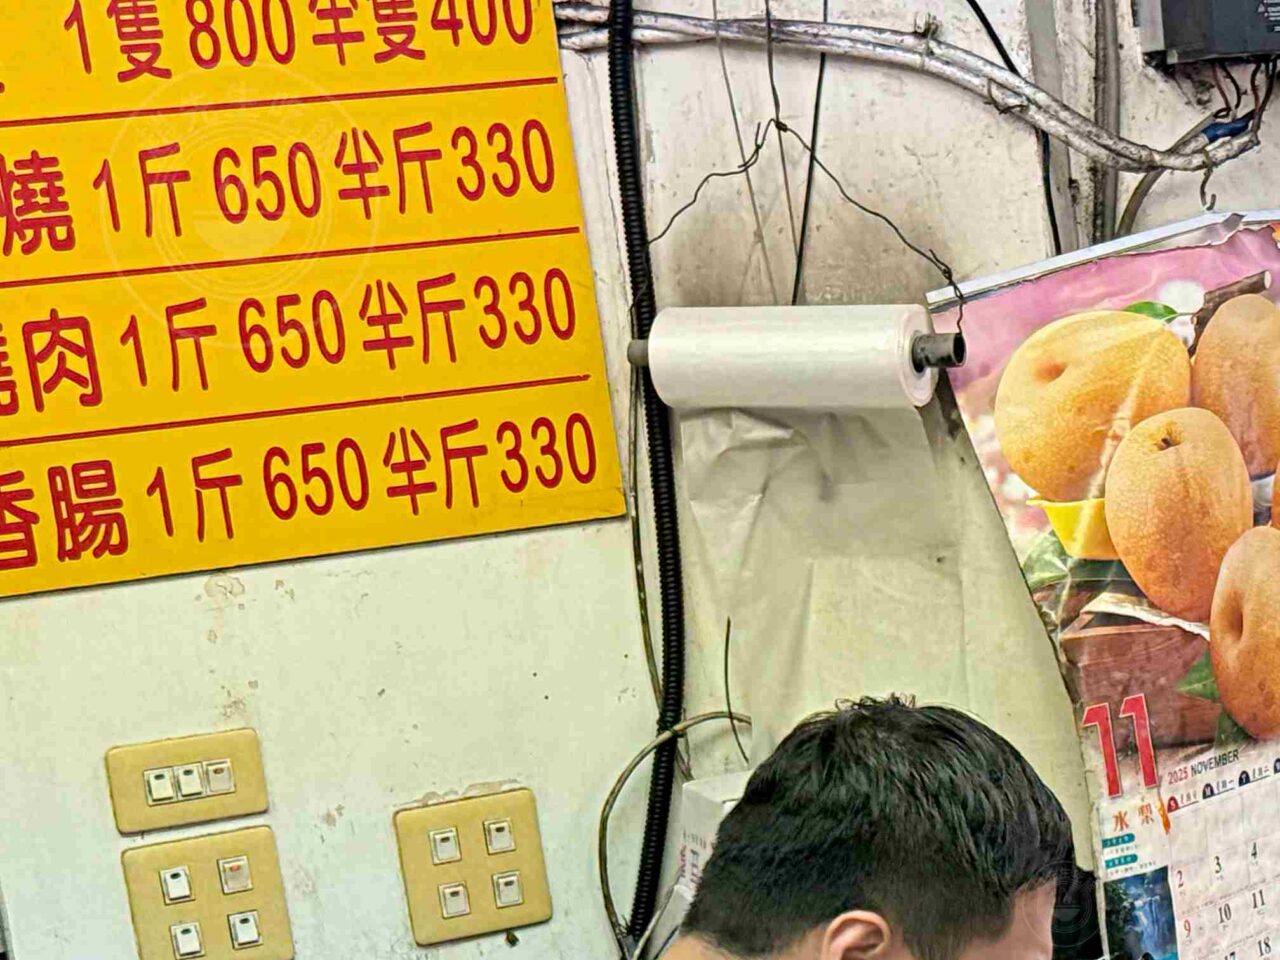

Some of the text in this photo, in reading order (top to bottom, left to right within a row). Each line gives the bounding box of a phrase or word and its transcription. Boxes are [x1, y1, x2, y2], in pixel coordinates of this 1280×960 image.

[0, 267, 577, 416] 肉1斤650半斤330
[1082, 693, 1159, 798] 11
[1167, 749, 1240, 785] 2025 NOVEMBER
[1177, 870, 1184, 888] 2
[1214, 856, 1222, 874] 3
[1251, 842, 1257, 859] 4
[1184, 919, 1191, 938] 9
[1218, 903, 1232, 924] 10
[1252, 889, 1265, 909] 11
[1258, 936, 1271, 957] 18
